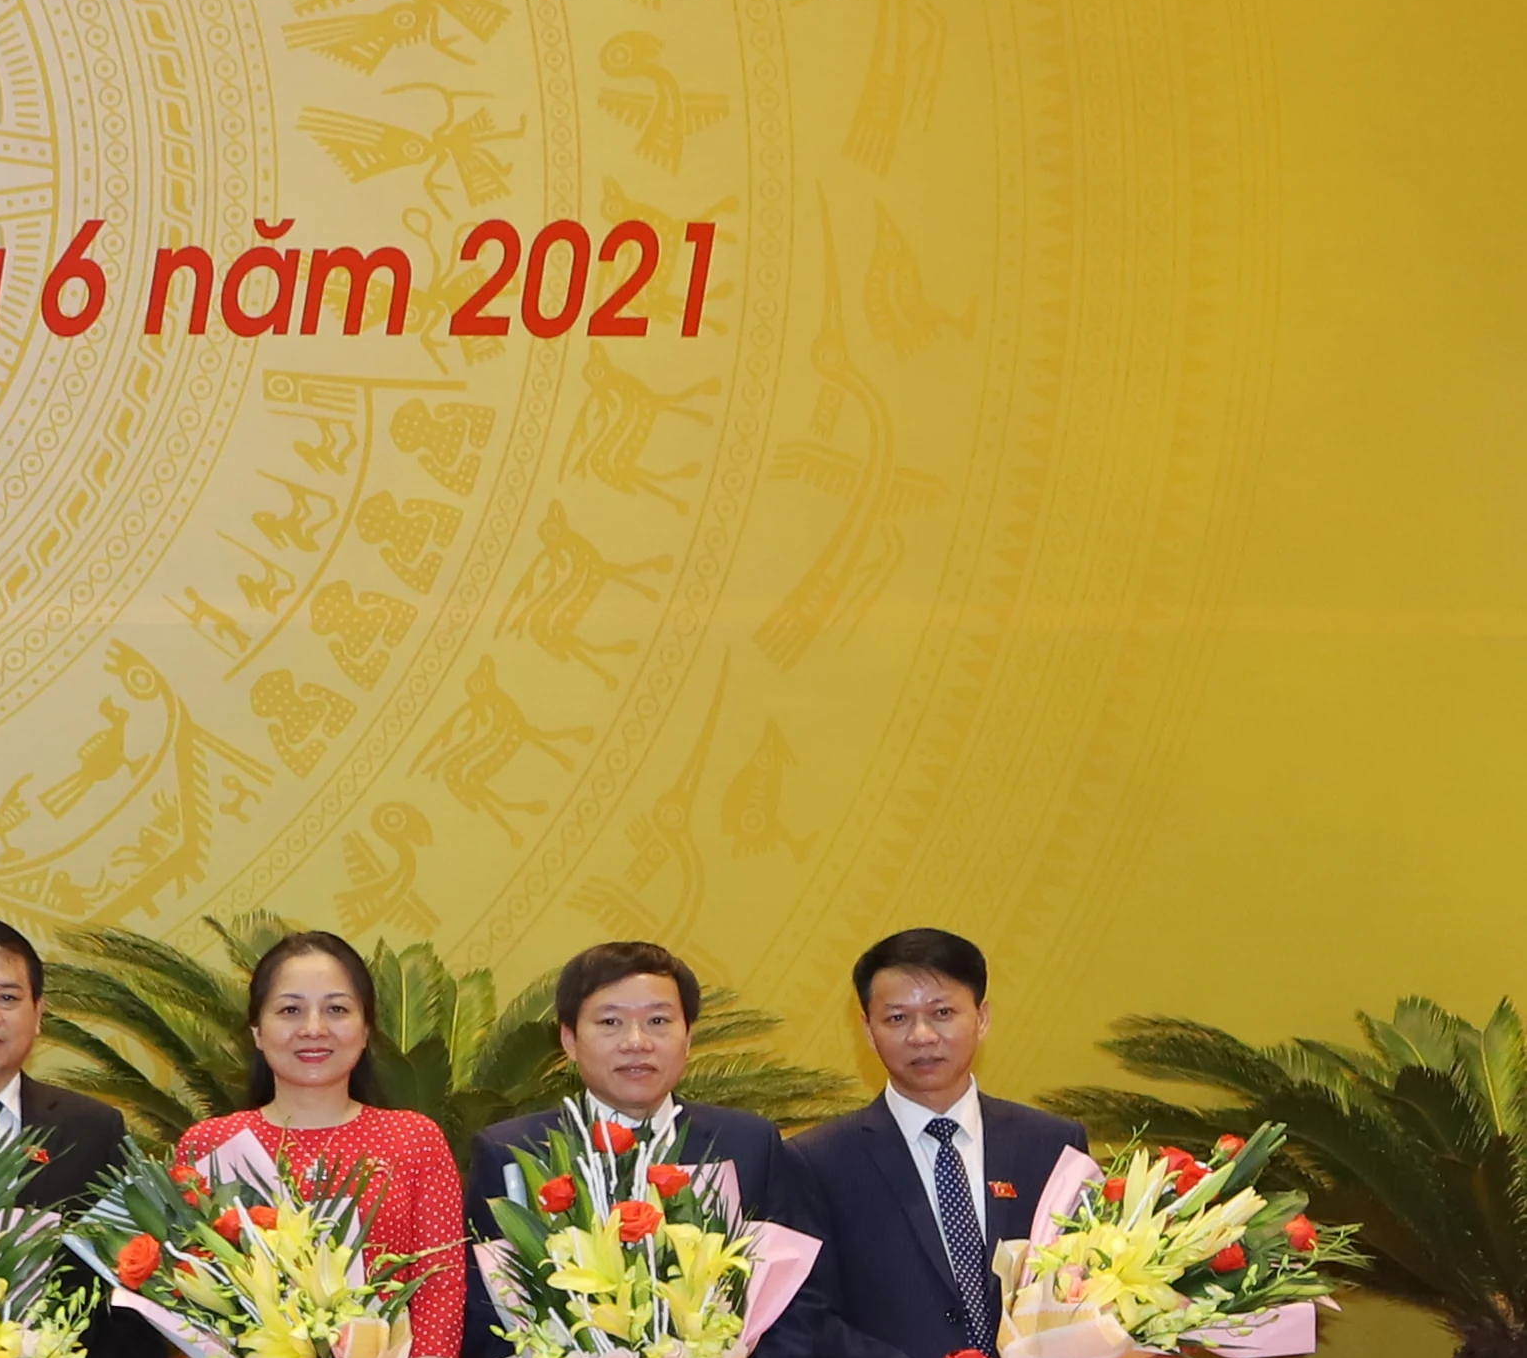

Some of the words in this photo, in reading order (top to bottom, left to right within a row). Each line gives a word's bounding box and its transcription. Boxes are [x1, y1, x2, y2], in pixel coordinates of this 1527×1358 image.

[40, 218, 108, 339] 6
[143, 217, 413, 339] năm
[449, 218, 717, 340] 2021
